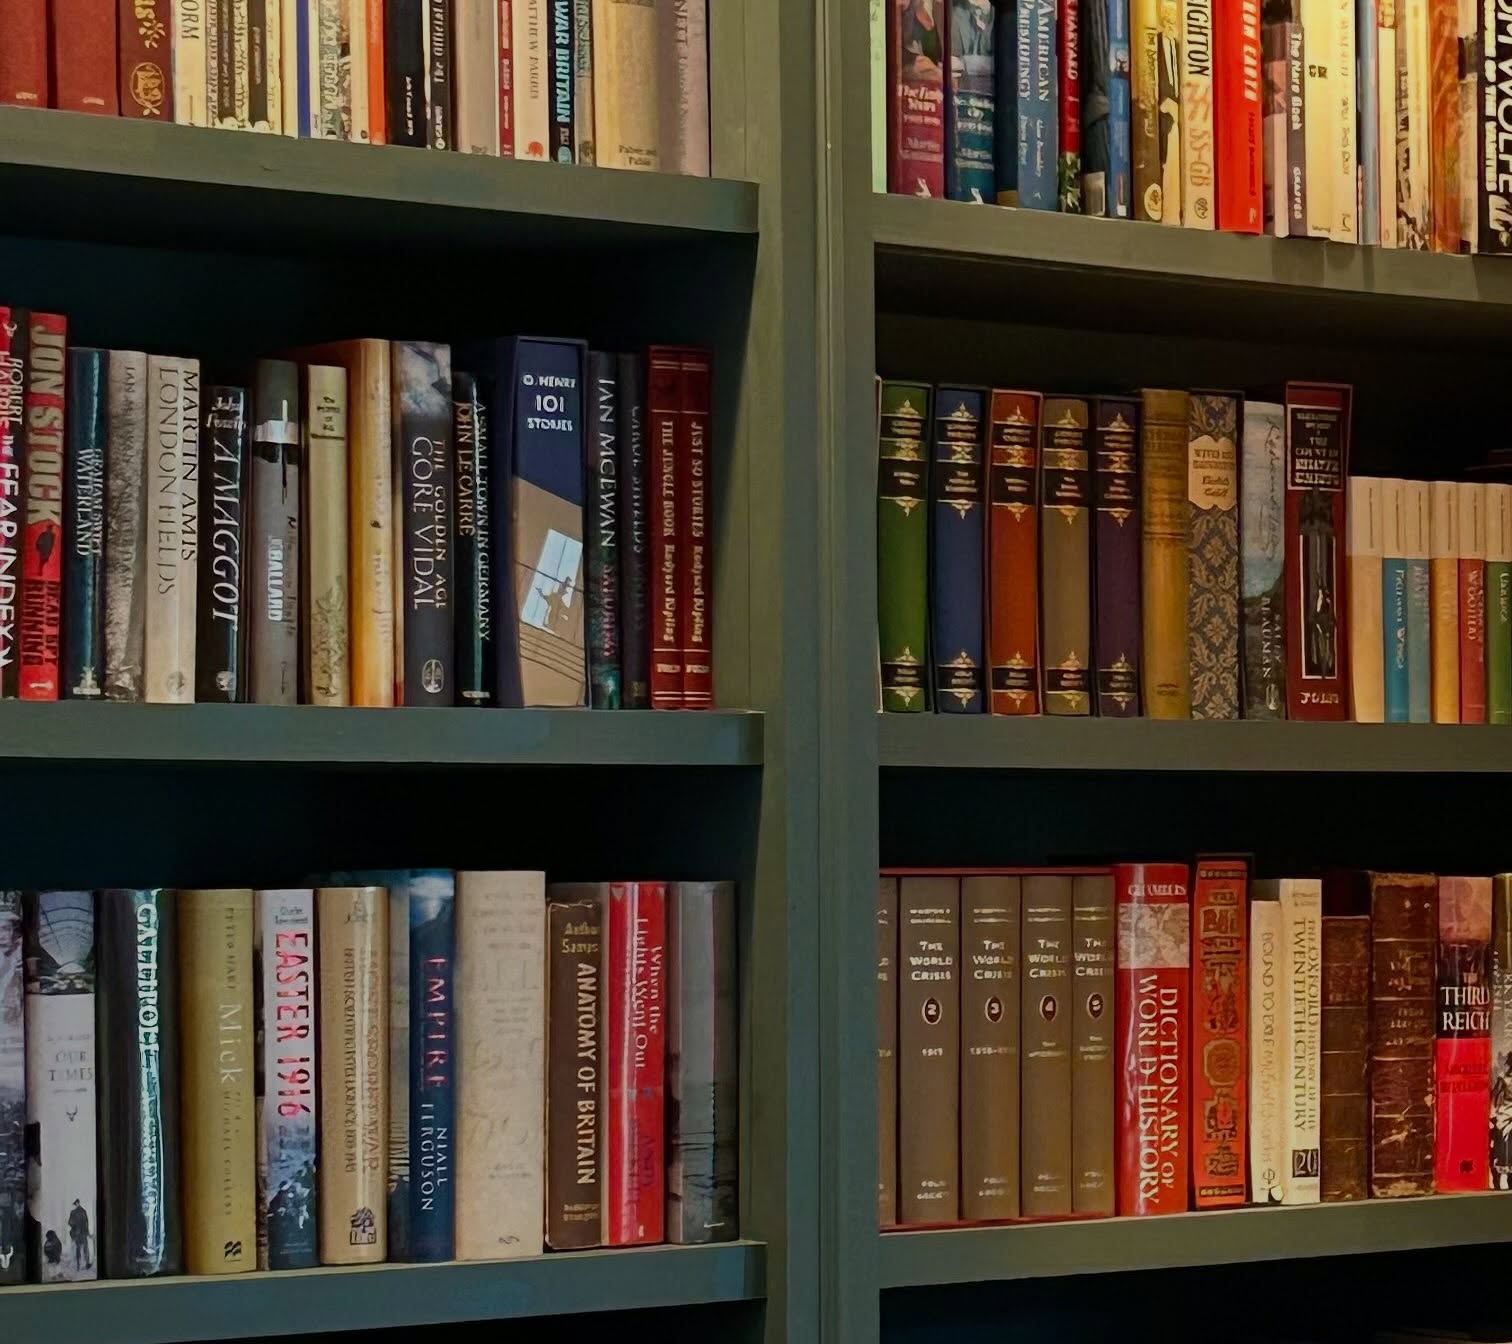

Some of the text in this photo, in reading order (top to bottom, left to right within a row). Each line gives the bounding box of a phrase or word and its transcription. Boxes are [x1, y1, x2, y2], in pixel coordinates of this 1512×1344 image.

[556, 49, 570, 122] BRITAIN
[27, 325, 64, 528] JON STOCK
[156, 367, 180, 596] LONDON FIELDS
[182, 369, 198, 562] MARTIN AMIS
[598, 379, 615, 423] IAN
[76, 448, 93, 556] WATERLAND
[212, 473, 240, 631] MAGGOT
[412, 436, 435, 610] GORE VIDAL
[218, 1002, 242, 1083] Mick
[275, 931, 311, 1118] EASTER 1916
[424, 954, 449, 1089] EMPIRE
[576, 963, 597, 1185] ANATOMY OF BRITAIN
[1294, 919, 1307, 1133] TWENTIETH CENTURY
[1440, 985, 1491, 1006] THIRD
[1442, 1011, 1491, 1030] REICH
[1138, 974, 1161, 1204] WORLD HISTORY
[1159, 988, 1178, 1189] DICTIONARY OF
